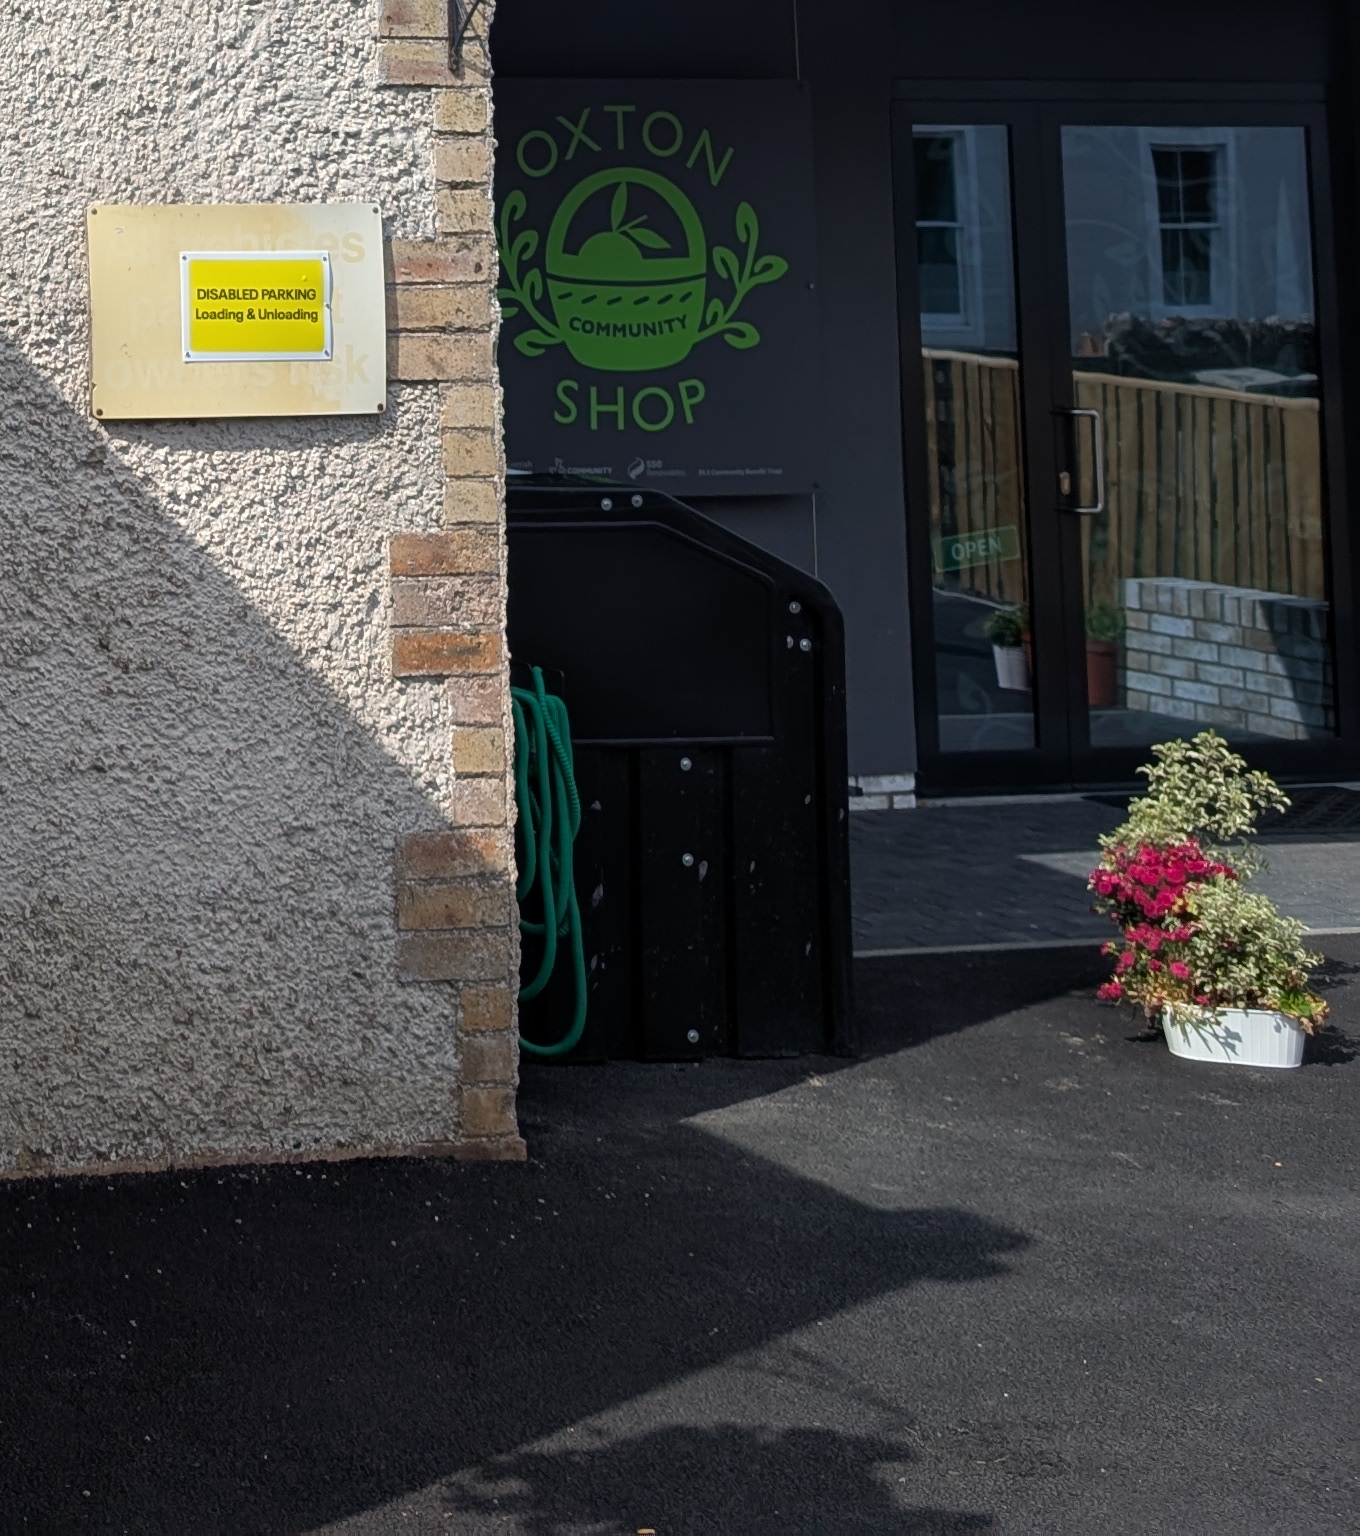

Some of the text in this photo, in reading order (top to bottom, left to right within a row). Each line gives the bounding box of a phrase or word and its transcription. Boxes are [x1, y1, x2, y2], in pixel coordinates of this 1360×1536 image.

[516, 105, 734, 186] OXTON
[196, 288, 317, 300] DISABLED PARKING
[195, 308, 319, 323] Loading & Unloading
[568, 314, 688, 338] COMMUNITY
[554, 379, 705, 431] SHOP
[951, 537, 1003, 561] OPEN
